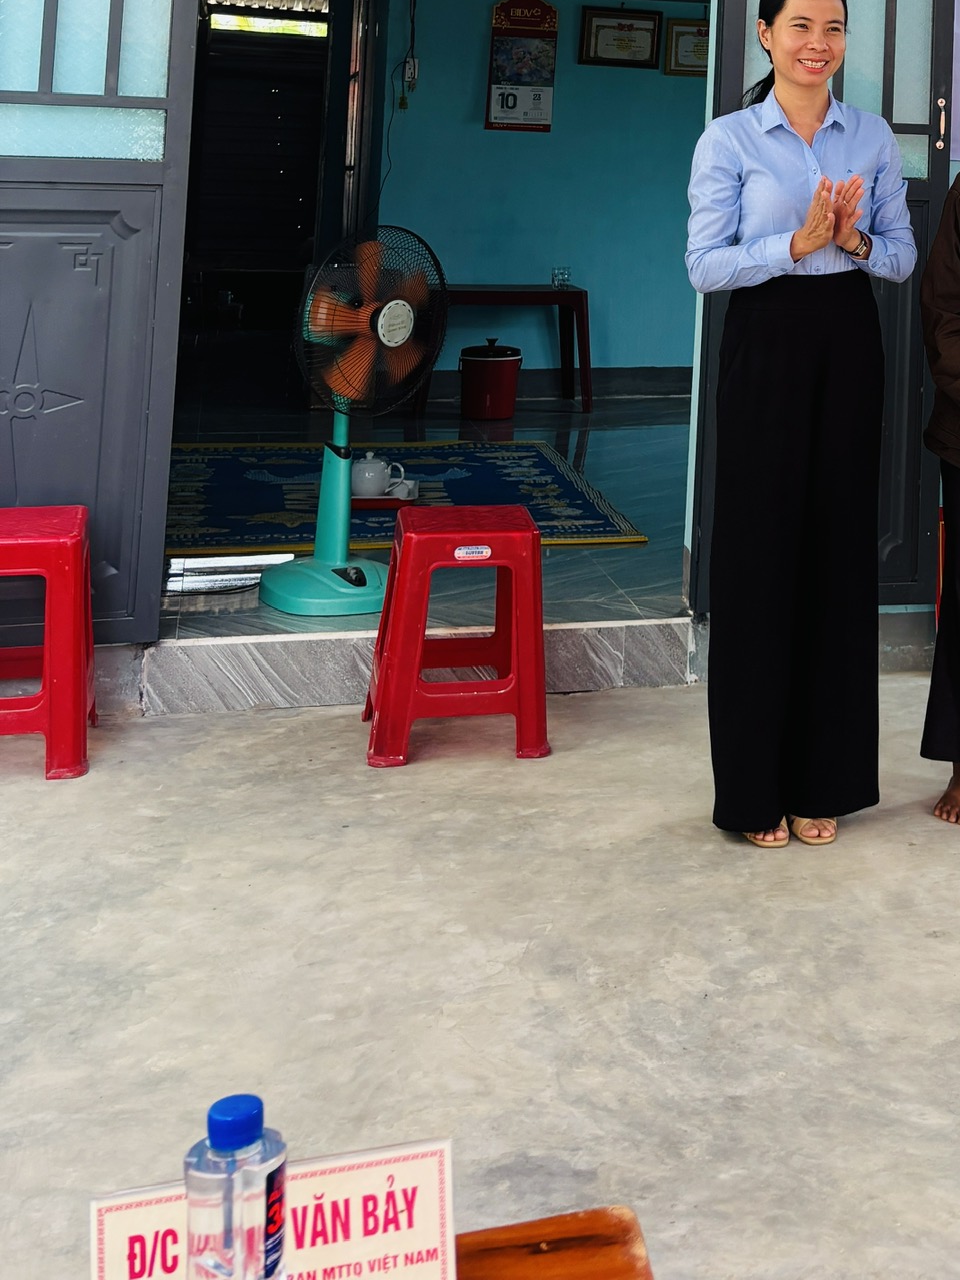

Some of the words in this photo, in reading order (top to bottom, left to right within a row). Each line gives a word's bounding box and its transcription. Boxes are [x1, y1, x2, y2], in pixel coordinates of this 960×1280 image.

[498, 91, 518, 109] 10
[532, 93, 542, 101] 23
[127, 1228, 179, 1280] Đ/C
[290, 1192, 351, 1251] VĂN
[362, 1174, 419, 1238] BẢY
[367, 1254, 399, 1274] VIỆT
[403, 1247, 439, 1267] NAM
